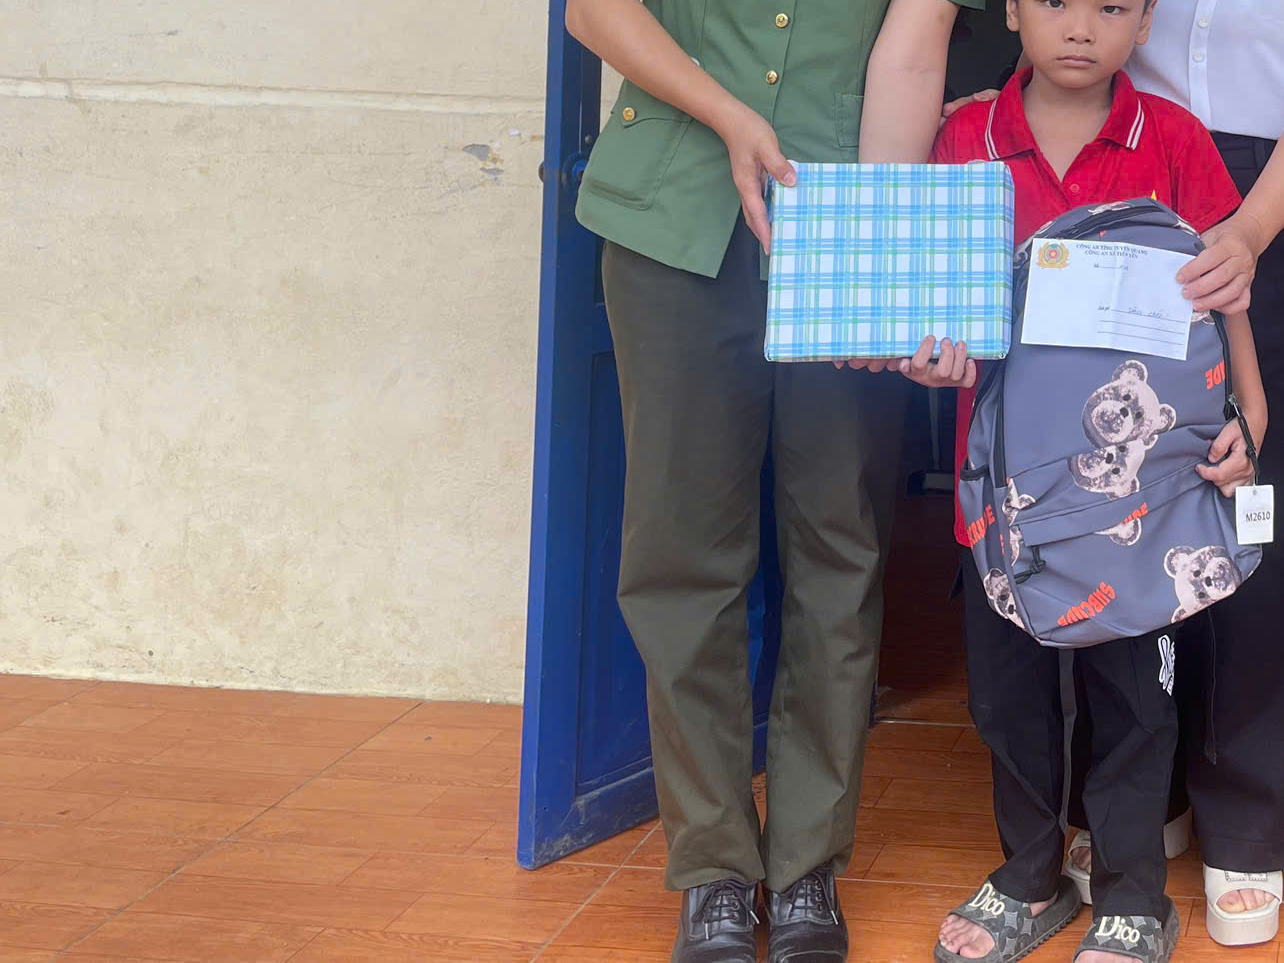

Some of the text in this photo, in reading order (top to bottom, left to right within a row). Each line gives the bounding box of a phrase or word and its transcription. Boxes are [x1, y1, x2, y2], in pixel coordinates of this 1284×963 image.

[1245, 511, 1271, 522] M2610
[968, 883, 1005, 916] Dico
[1095, 916, 1140, 943] Dico
